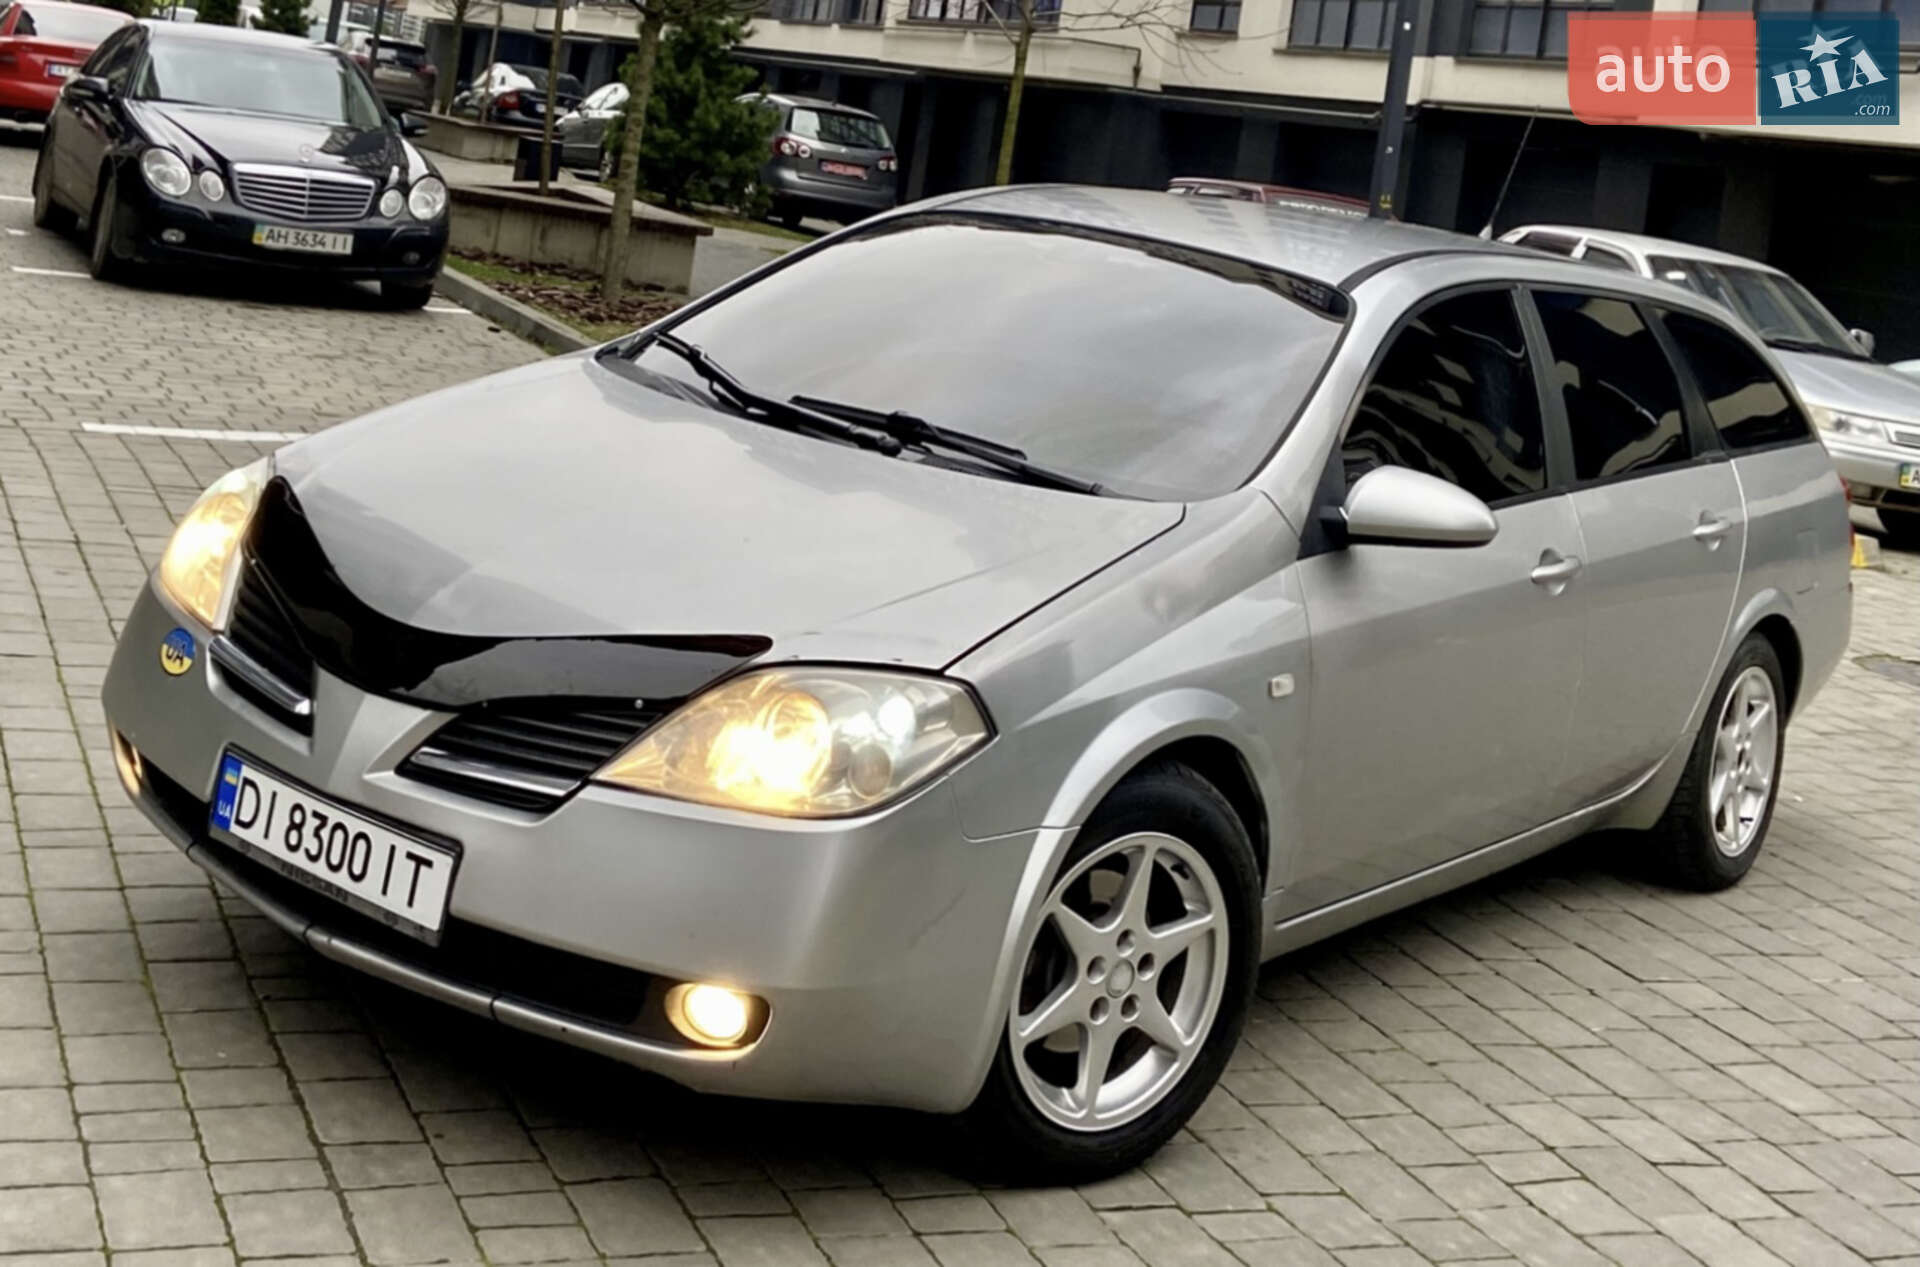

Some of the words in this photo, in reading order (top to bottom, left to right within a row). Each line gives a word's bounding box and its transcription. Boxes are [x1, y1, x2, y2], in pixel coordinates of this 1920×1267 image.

[265, 228, 289, 244] AH
[291, 231, 327, 249] 3634
[165, 643, 186, 668] UA
[217, 800, 231, 818] UA
[234, 776, 278, 840] DI
[284, 802, 372, 883] 8300
[381, 844, 434, 909] IT
